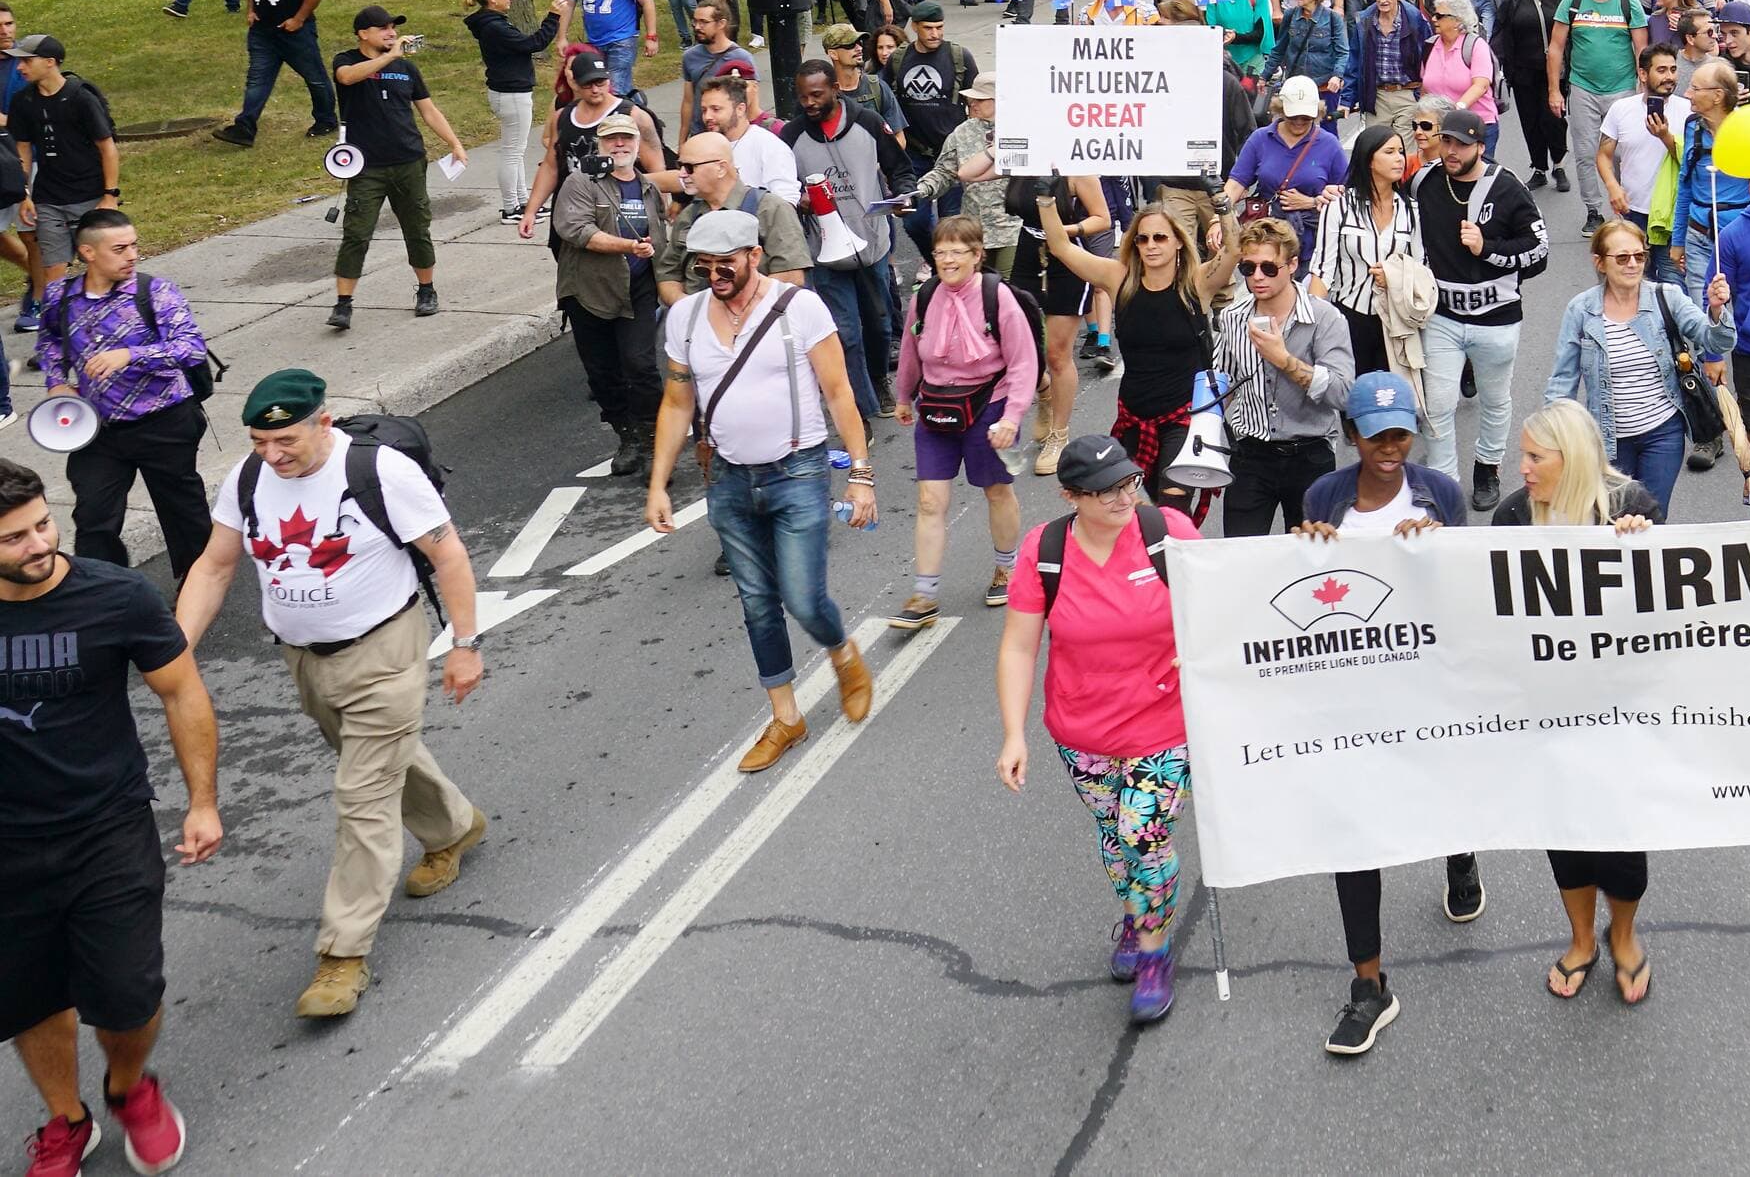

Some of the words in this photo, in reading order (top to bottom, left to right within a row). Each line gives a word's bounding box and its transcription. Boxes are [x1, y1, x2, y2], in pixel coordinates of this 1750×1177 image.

[1072, 37, 1134, 60] MAKE
[381, 72, 409, 81] NEWS
[1067, 102, 1146, 127] GREAT
[831, 183, 857, 194] hoix
[268, 584, 336, 603] POLICE
[1243, 621, 1437, 665] INFIRMIER(E)S
[1532, 633, 1577, 663] De
[1258, 668, 1272, 679] DE
[1275, 658, 1327, 677] PREMIÈRE
[1329, 656, 1359, 672] LIGNE
[1361, 654, 1376, 668] DU
[1378, 650, 1420, 666] CANADA
[1241, 743, 1286, 766] Let
[1294, 737, 1323, 755] us
[1333, 726, 1406, 752] never
[1415, 713, 1530, 742] consider
[1539, 704, 1662, 730] ourselves
